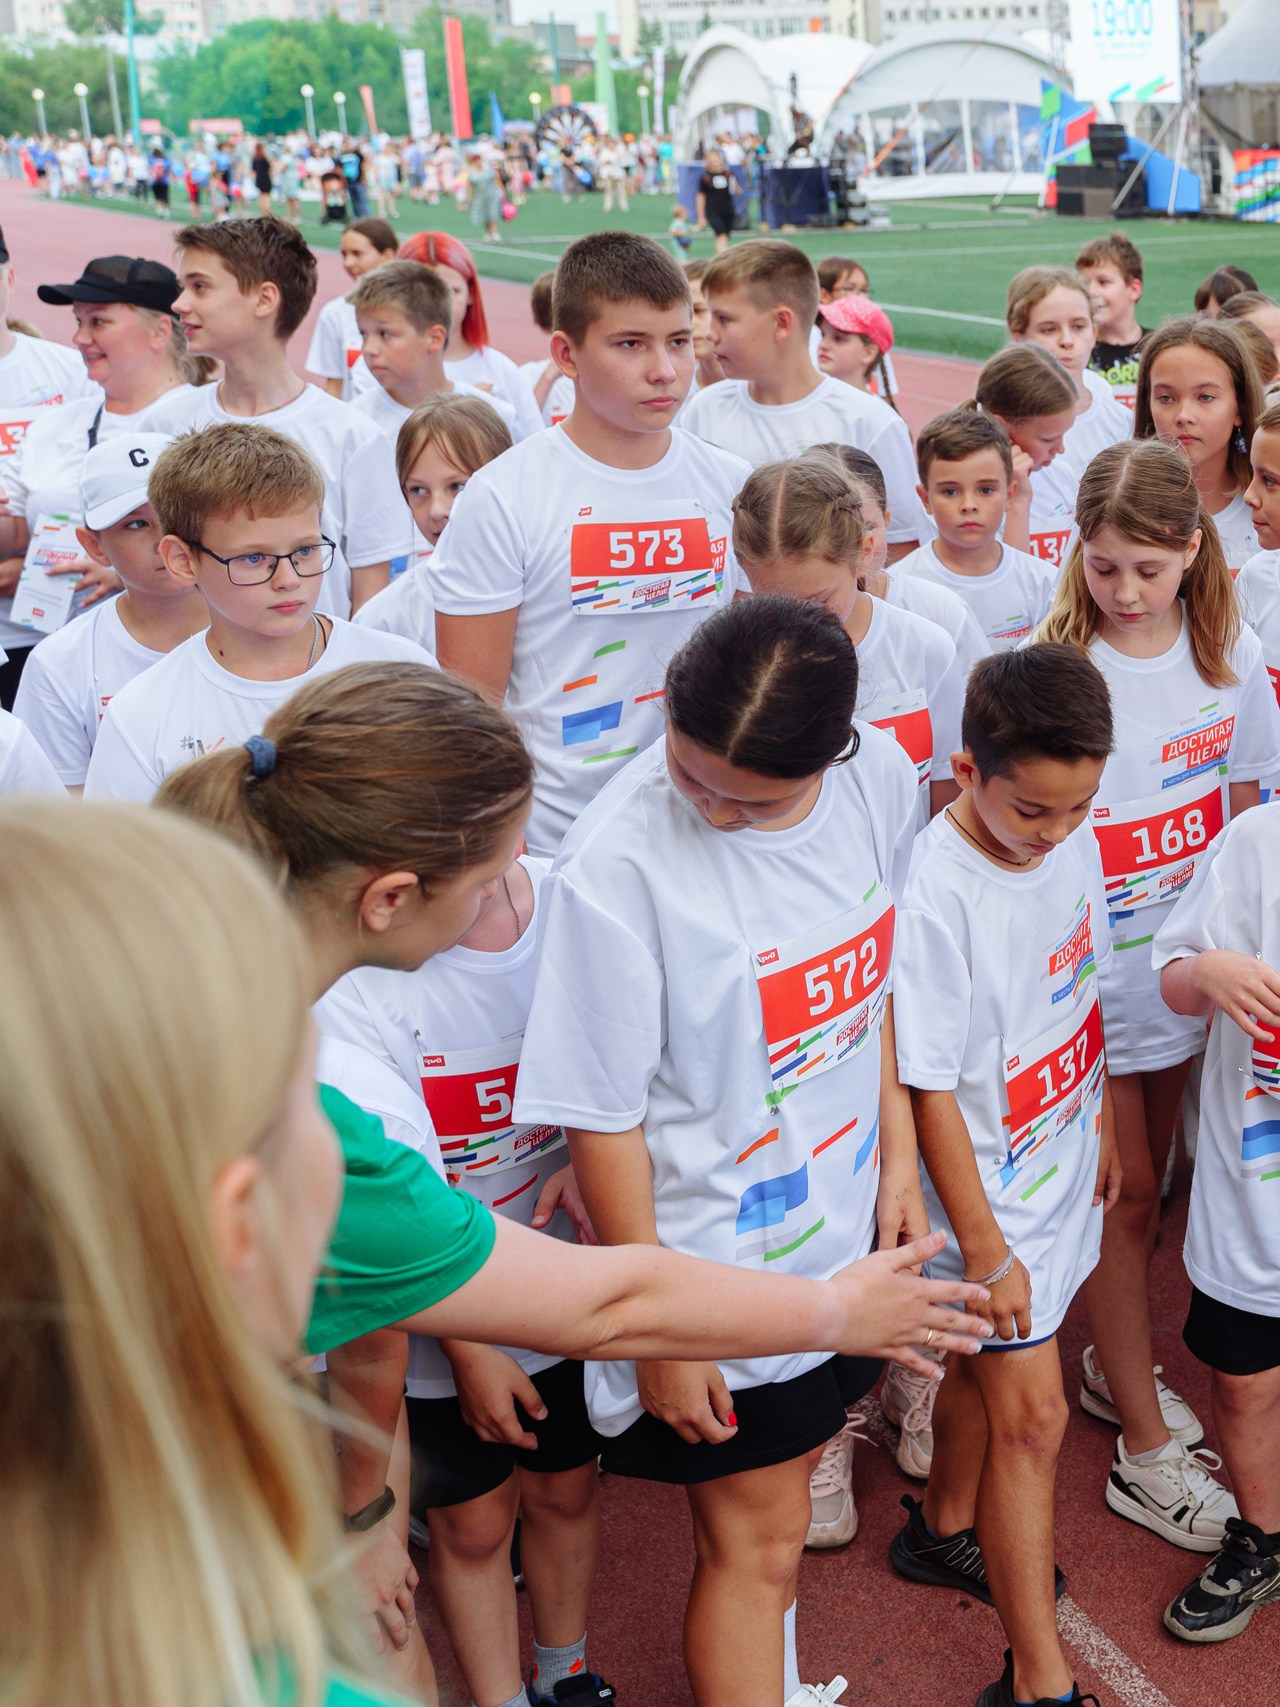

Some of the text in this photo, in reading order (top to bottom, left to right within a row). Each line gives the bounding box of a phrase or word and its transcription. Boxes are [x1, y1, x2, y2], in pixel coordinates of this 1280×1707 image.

[1092, 0, 1152, 36] 19:00
[129, 447, 149, 467] C
[609, 528, 685, 568] 573
[1167, 719, 1233, 760] ДОСТИГАЯ
[1131, 808, 1206, 864] 168
[1055, 917, 1091, 972] ДОСТИГ
[804, 936, 879, 1017] 572
[1037, 1028, 1088, 1107] 137
